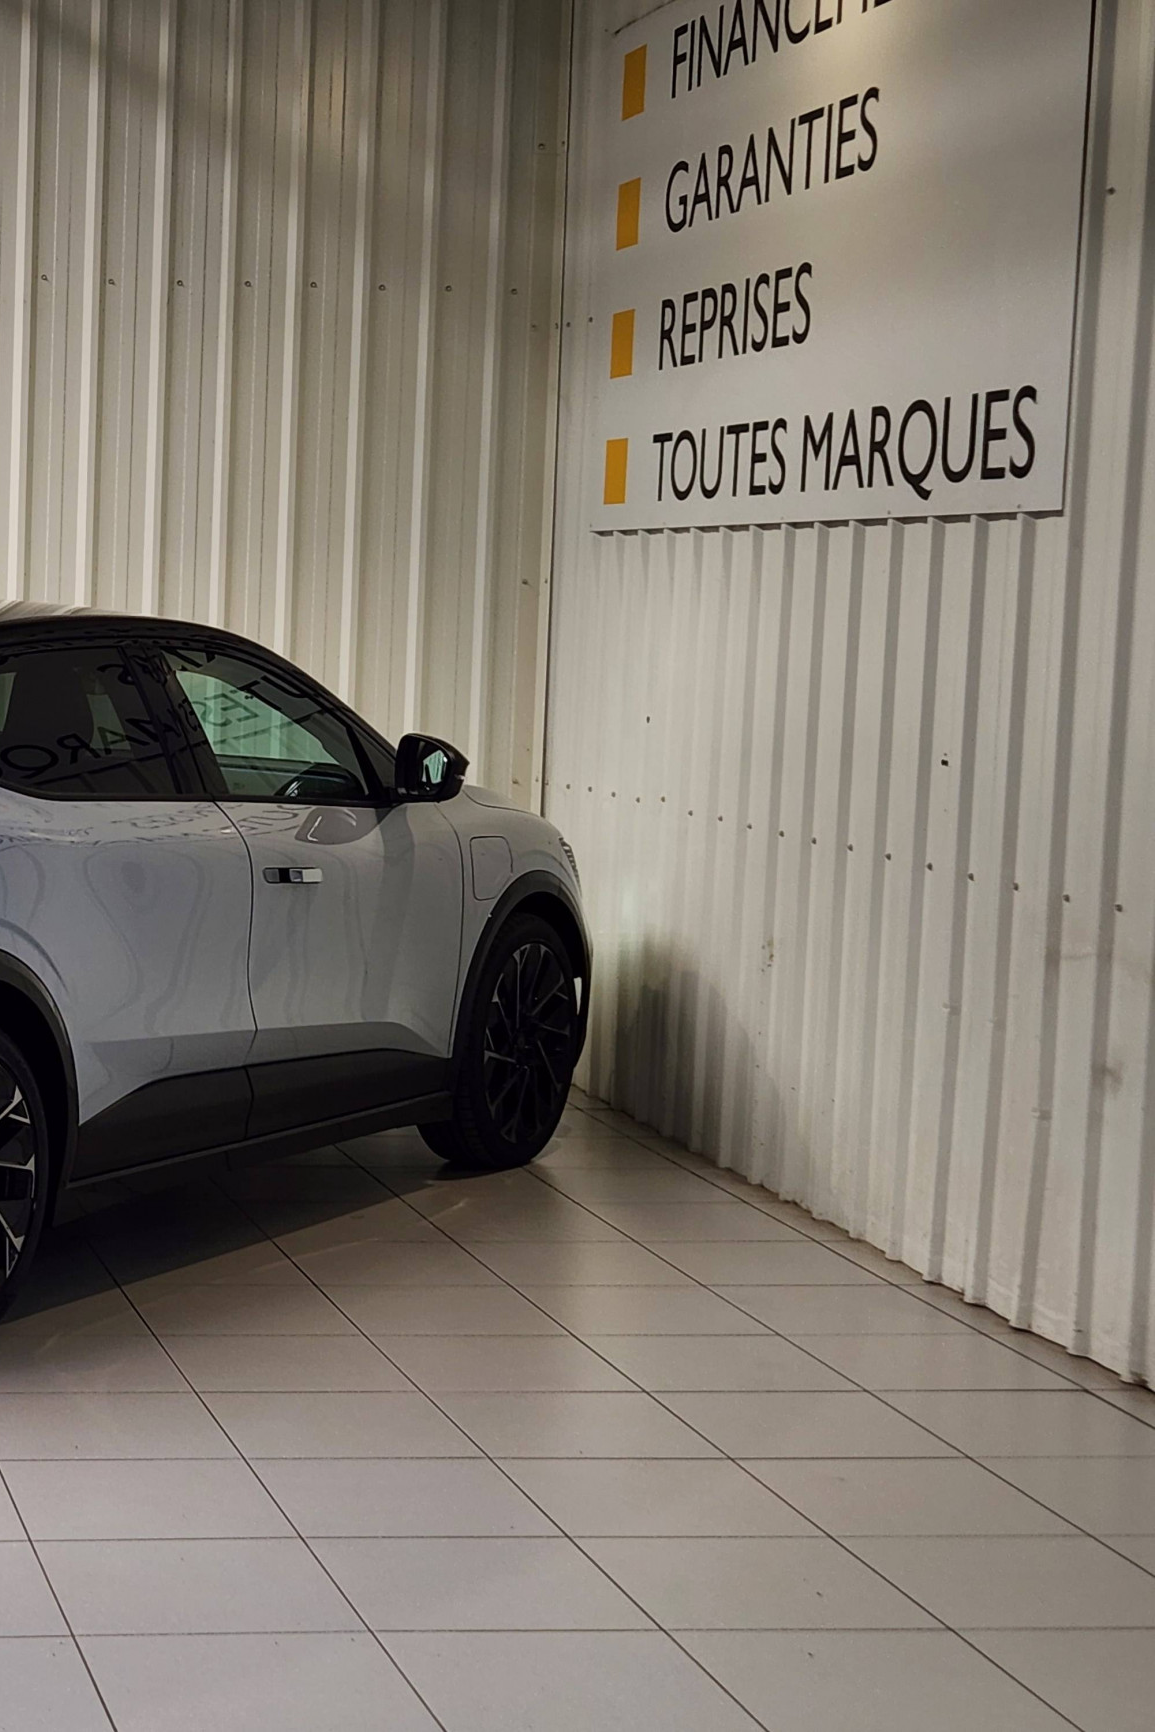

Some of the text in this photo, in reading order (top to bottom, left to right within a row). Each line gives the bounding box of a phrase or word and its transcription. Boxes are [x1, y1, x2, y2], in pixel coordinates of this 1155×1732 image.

[671, 0, 892, 98] FINANC
[665, 87, 880, 233] GARANTIES
[658, 262, 812, 371] REPRISES
[652, 385, 1037, 502] TOUTES MARQUES
